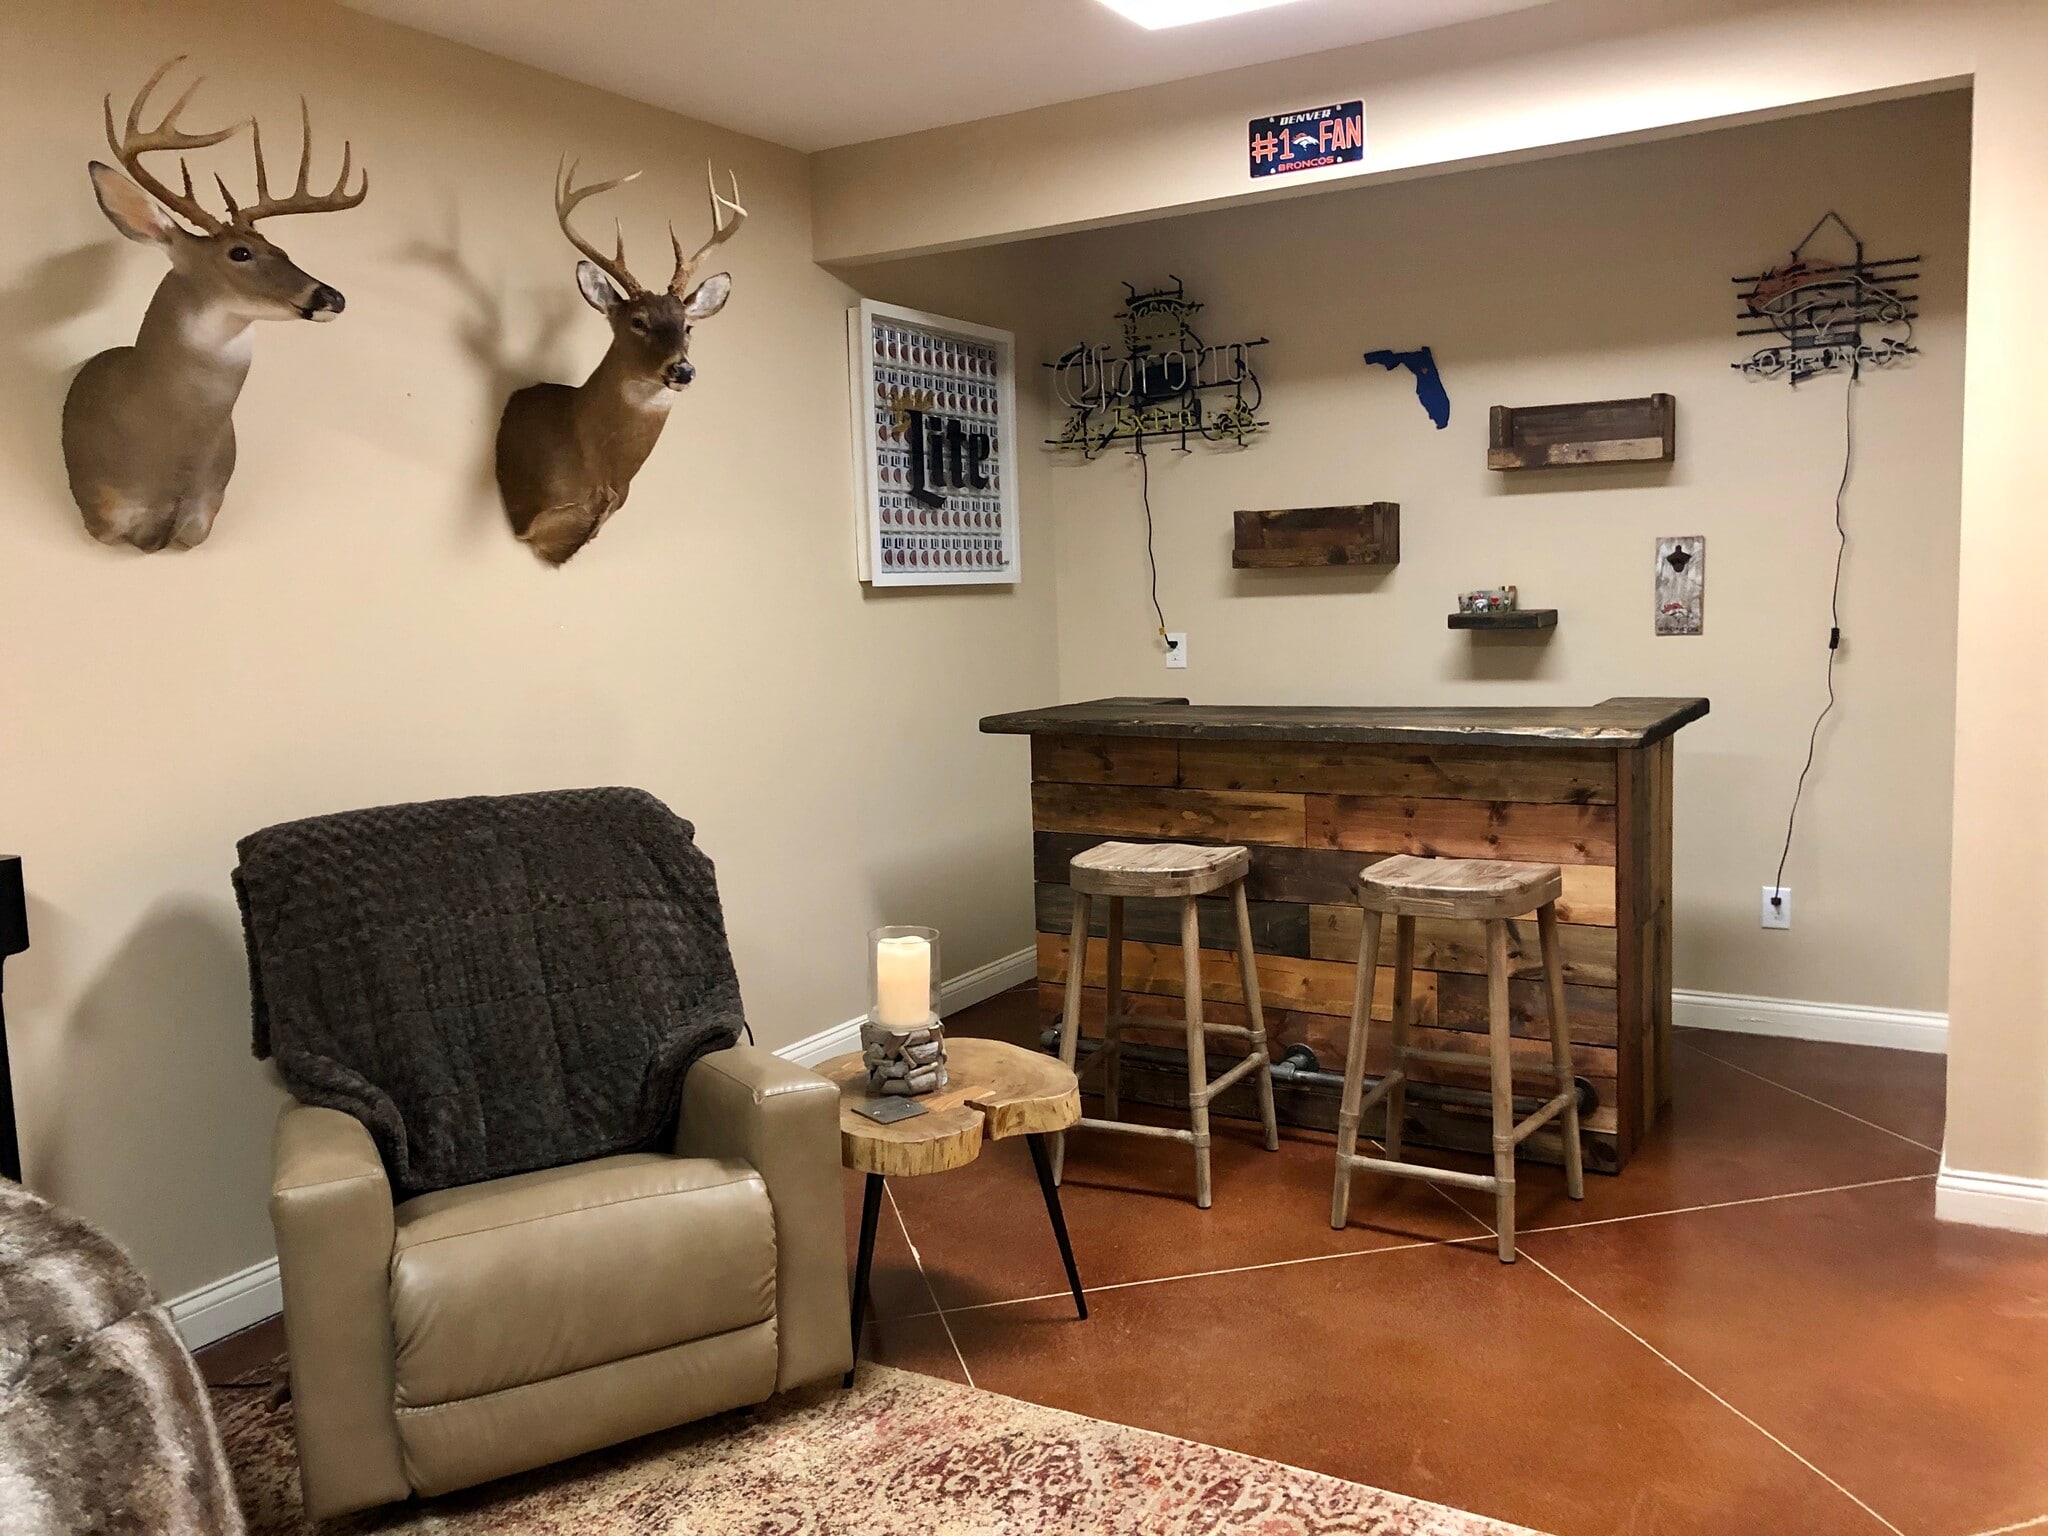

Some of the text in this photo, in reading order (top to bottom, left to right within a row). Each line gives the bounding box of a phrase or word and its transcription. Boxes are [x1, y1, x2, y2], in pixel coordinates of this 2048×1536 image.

[1279, 109, 1332, 126] DENVER
[1251, 115, 1362, 164] #1 FAN
[1278, 155, 1335, 172] BRONCOS
[1053, 342, 1251, 414] Corona
[1111, 404, 1195, 435] Extra
[904, 408, 991, 509] Lite
